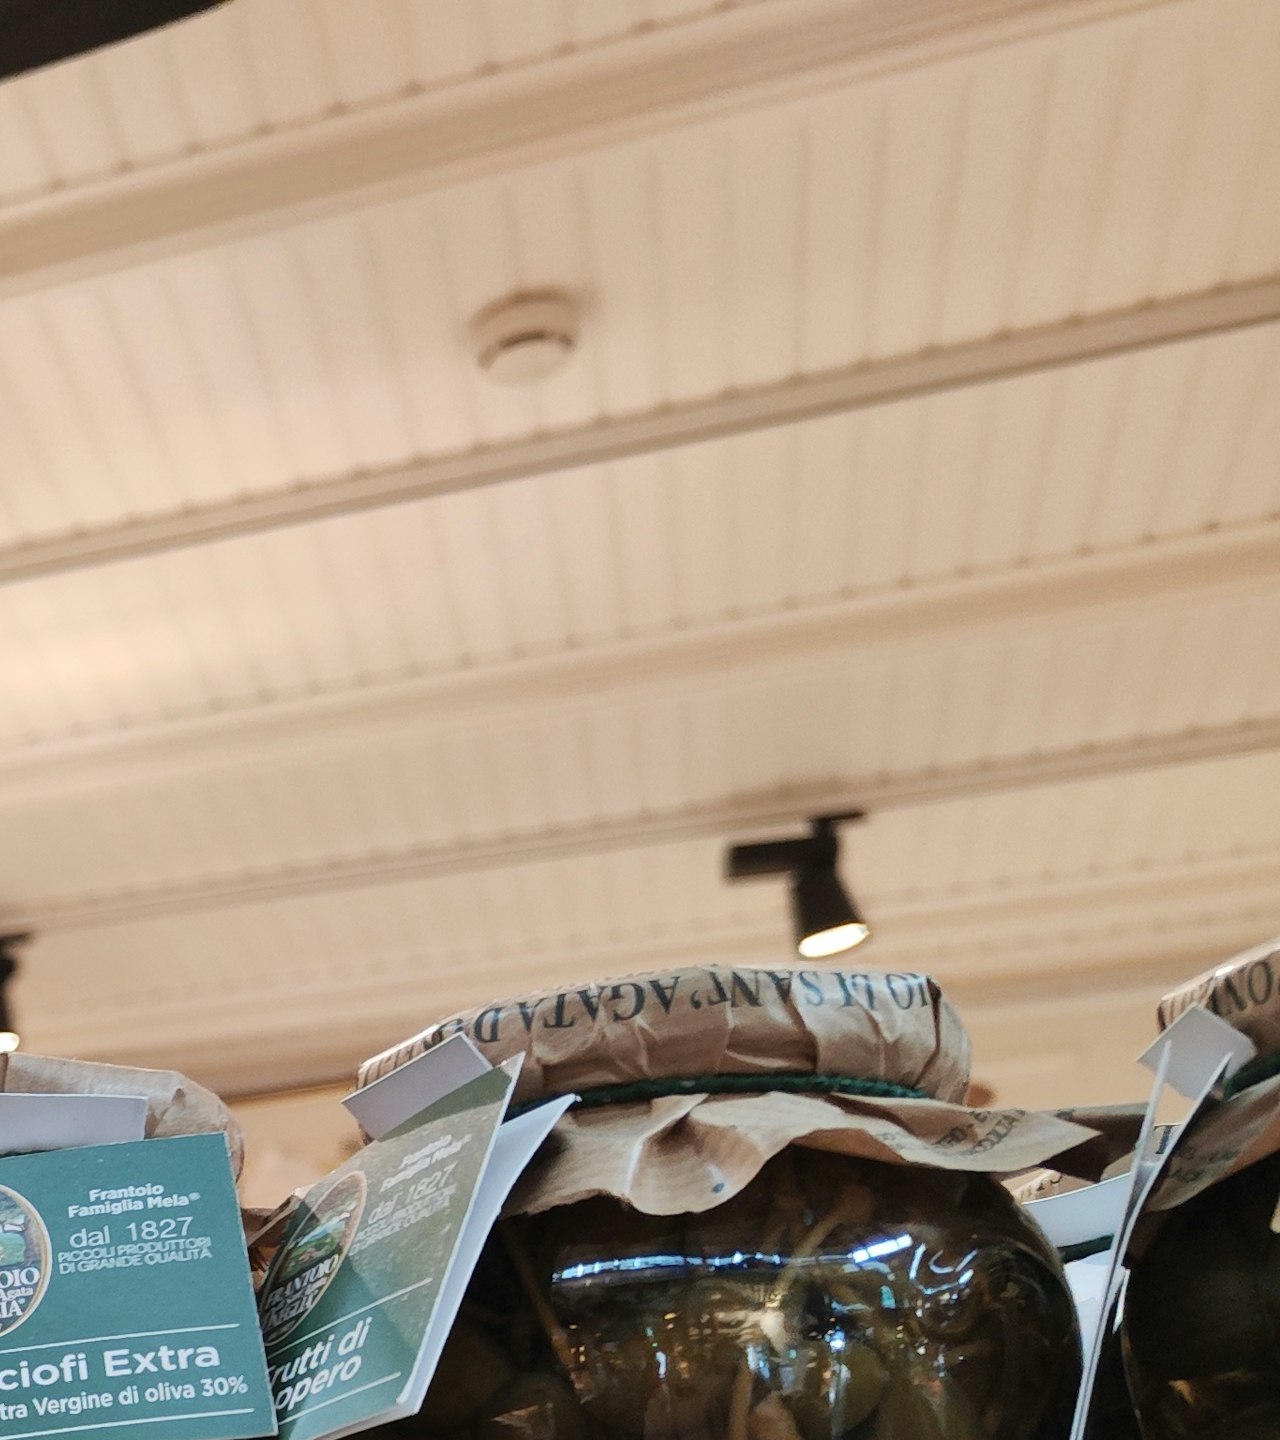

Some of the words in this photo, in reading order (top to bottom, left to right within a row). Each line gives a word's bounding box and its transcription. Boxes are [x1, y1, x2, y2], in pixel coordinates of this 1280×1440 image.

[67, 1198, 144, 1218] Famiglia
[88, 1183, 164, 1202] Frantoio
[69, 1224, 110, 1248] dal
[126, 1215, 193, 1241] 1827
[337, 1315, 372, 1357] di
[103, 1345, 220, 1377] Extra
[31, 1391, 113, 1415] Vergine
[118, 1384, 139, 1405] di
[145, 1381, 195, 1402] oliva
[200, 1374, 248, 1397] 30%
